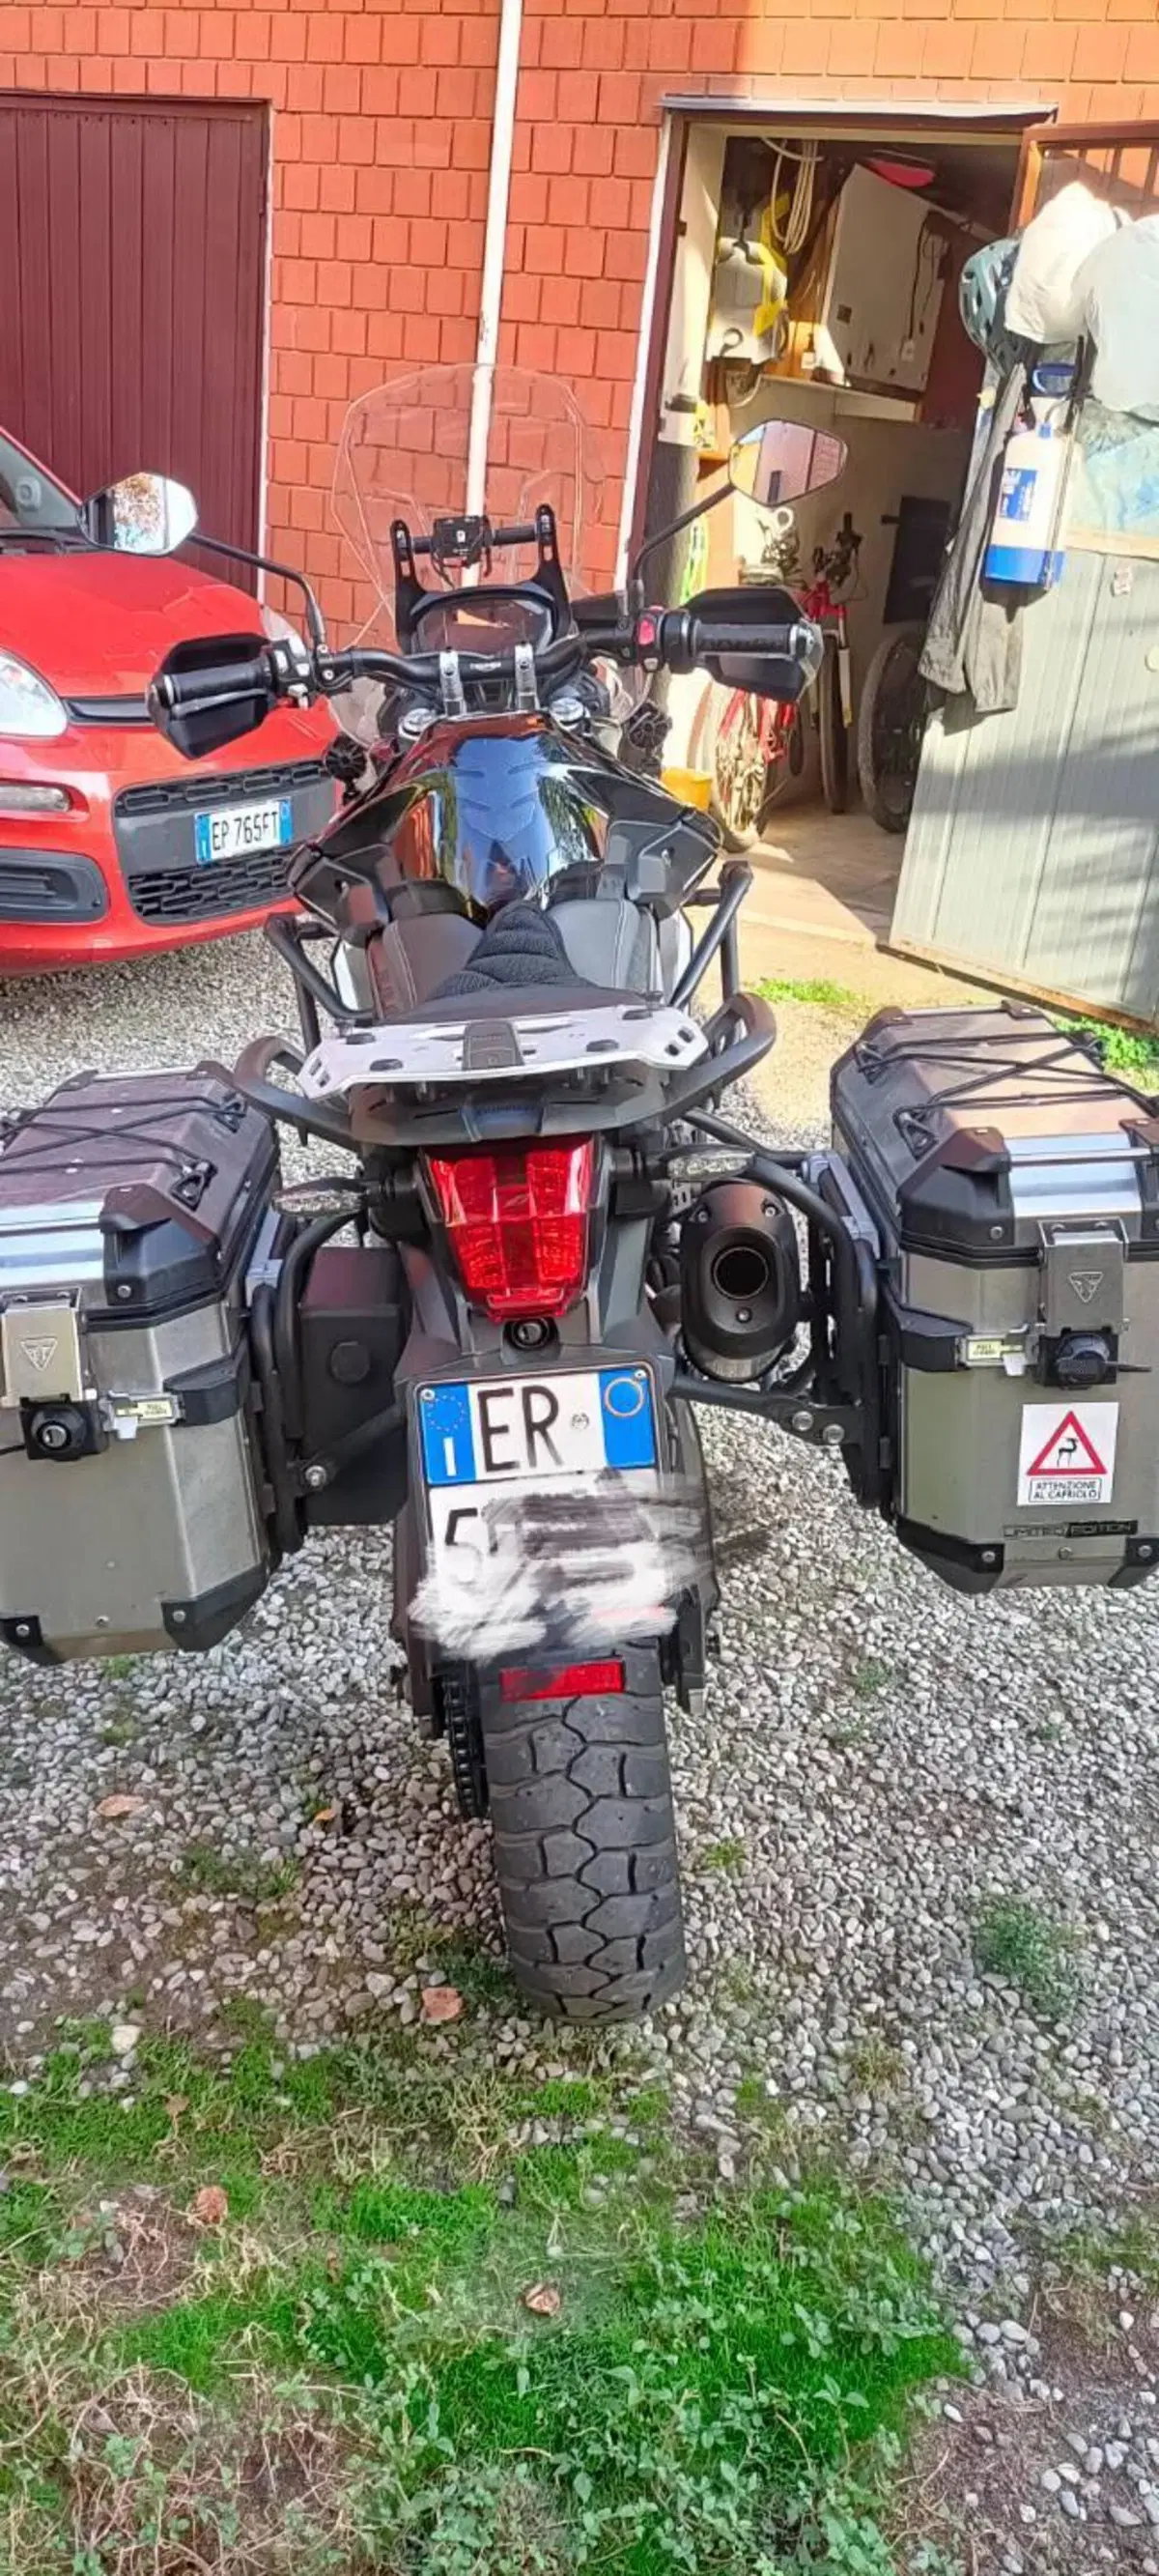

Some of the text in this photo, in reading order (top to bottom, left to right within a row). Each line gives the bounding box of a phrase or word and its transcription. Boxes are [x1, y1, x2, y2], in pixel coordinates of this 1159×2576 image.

[212, 812, 278, 851] EP 765FT
[477, 1386, 566, 1473] ER
[1048, 1490, 1097, 1499] CAPRIOLO
